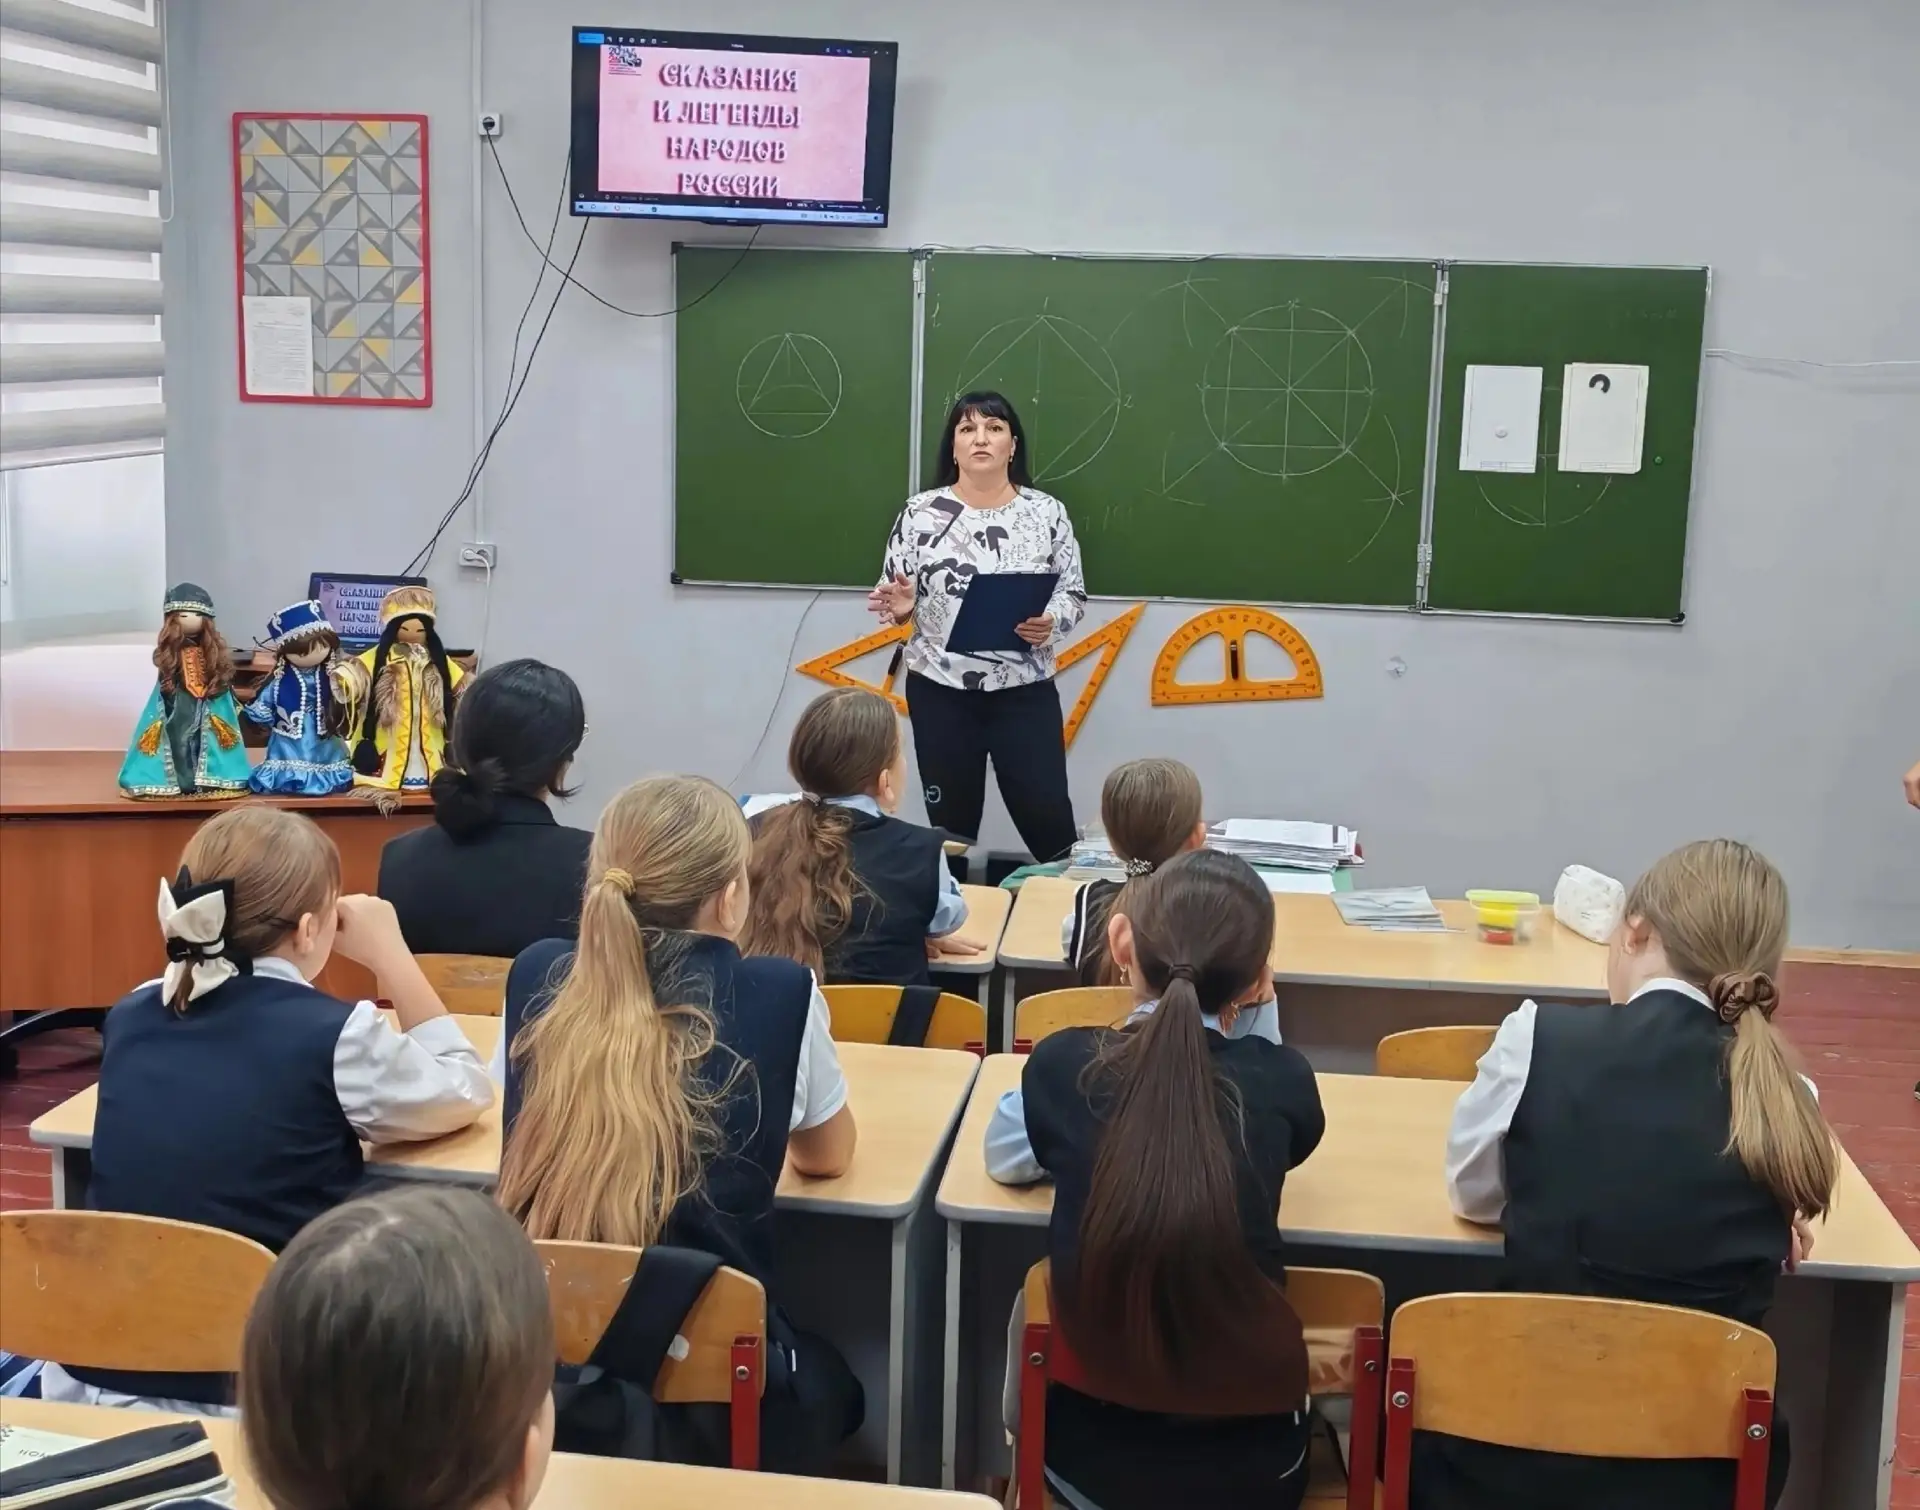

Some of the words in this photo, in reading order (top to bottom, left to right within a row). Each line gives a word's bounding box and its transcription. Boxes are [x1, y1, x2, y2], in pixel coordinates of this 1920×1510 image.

[658, 63, 799, 92] СКАЗАНИЯ
[653, 100, 671, 123] И
[677, 101, 801, 128] ЛЕГЕНДЫ
[666, 136, 788, 163] НАРОДОВ
[677, 173, 781, 197] РОССИИ
[339, 586, 386, 598] СКАЗАНИ
